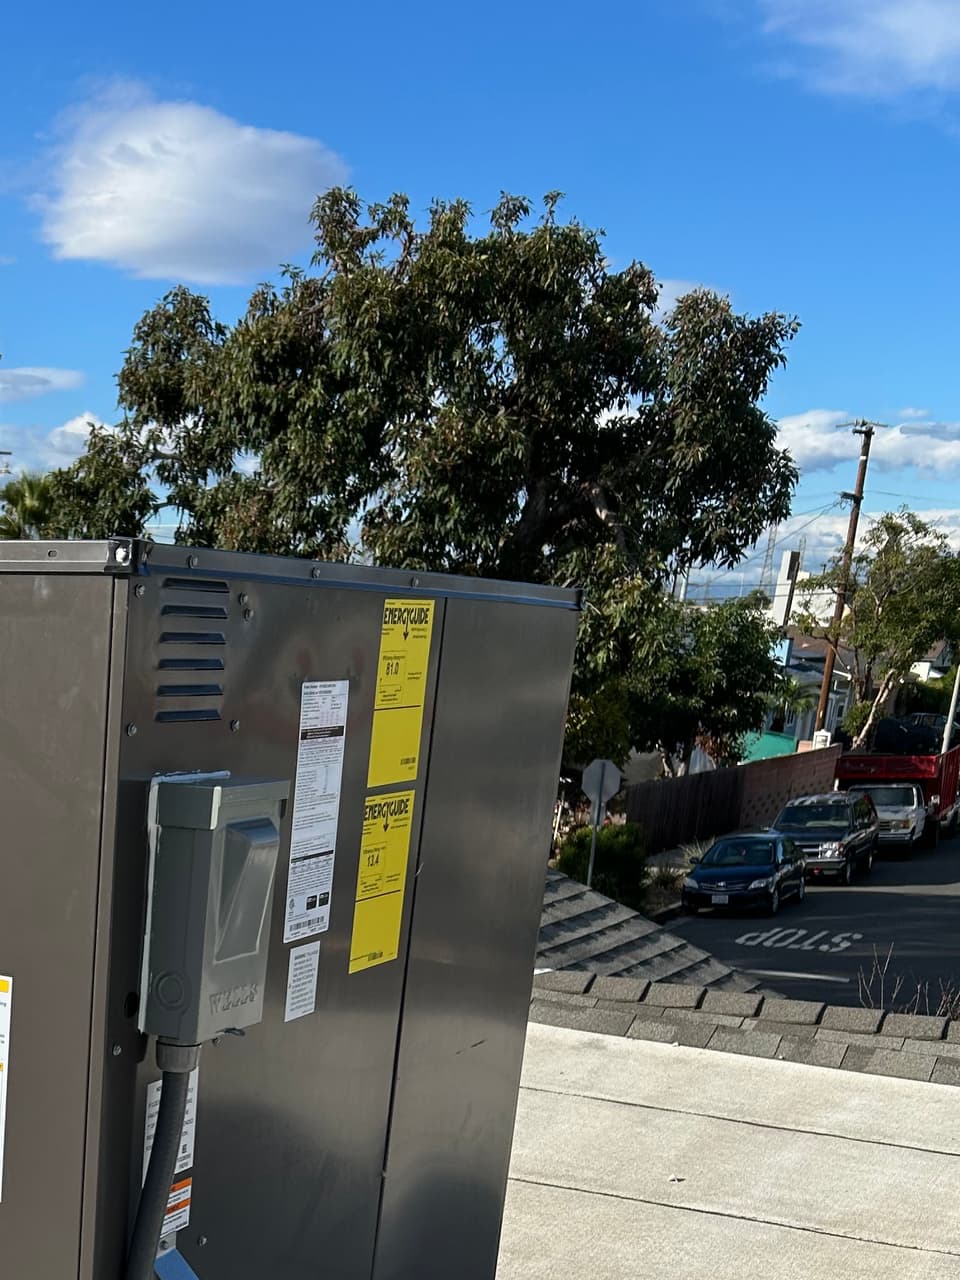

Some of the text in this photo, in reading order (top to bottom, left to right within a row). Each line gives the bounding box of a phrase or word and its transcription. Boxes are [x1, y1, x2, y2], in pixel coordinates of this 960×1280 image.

[383, 607, 430, 625] ENERGYGUIDE
[385, 661, 400, 676] 81.0
[363, 798, 411, 821] ENERGYGUIDE
[367, 853, 380, 867] 13.4
[735, 927, 863, 952] STOP
